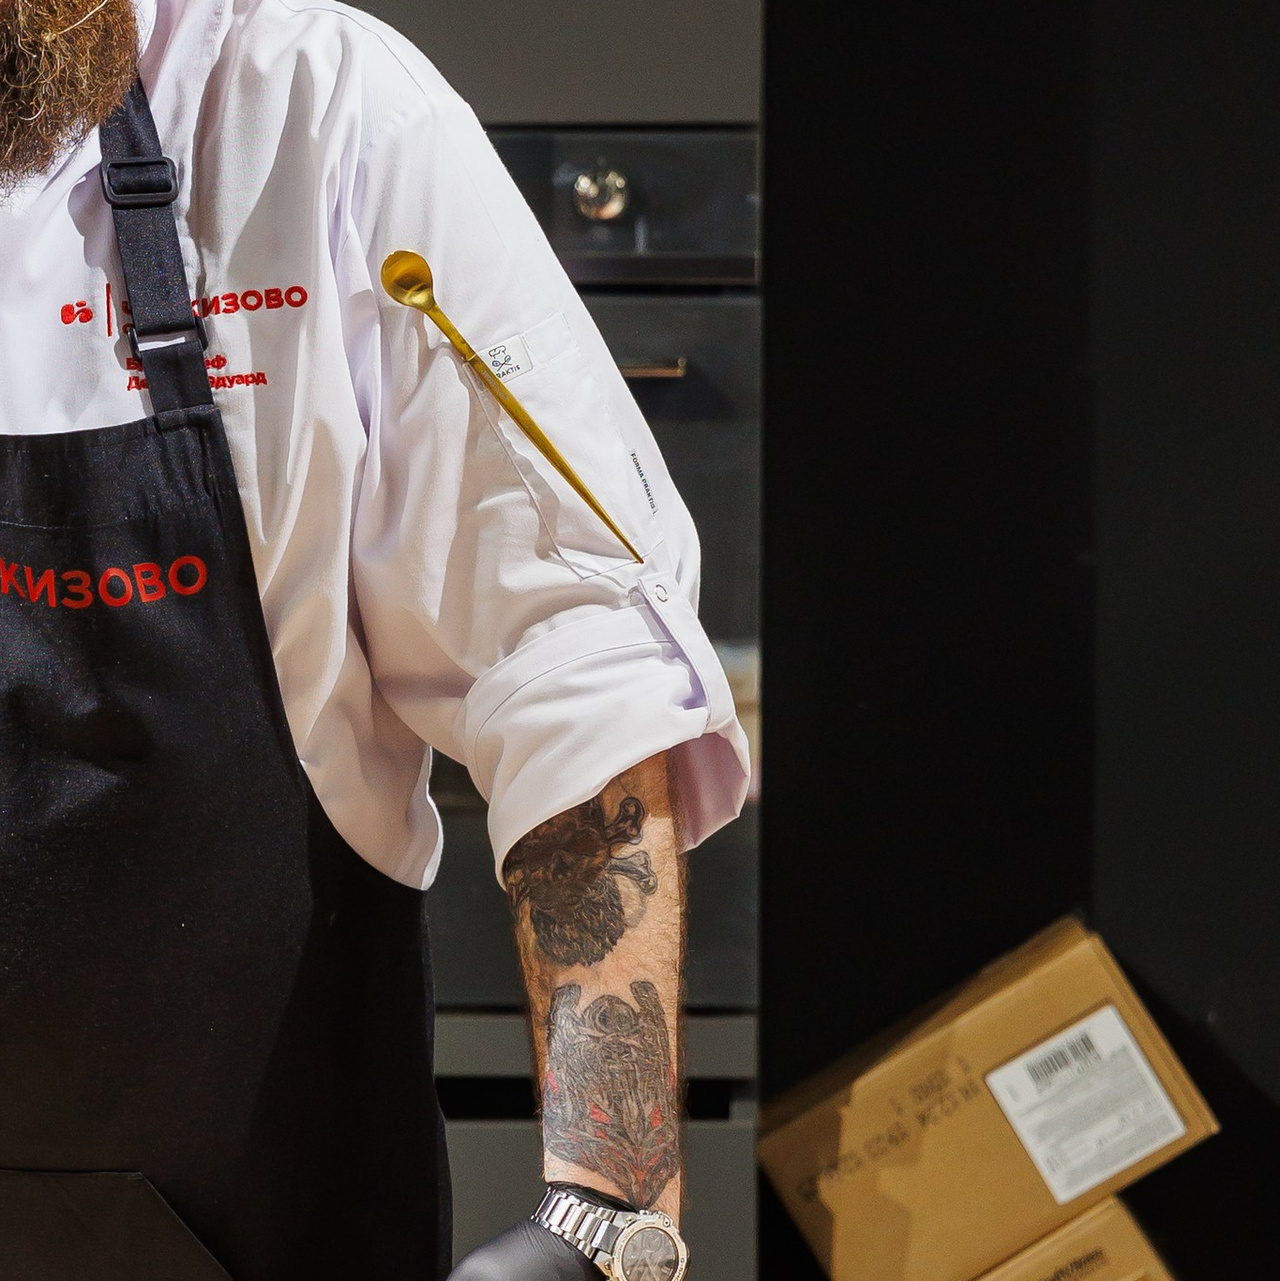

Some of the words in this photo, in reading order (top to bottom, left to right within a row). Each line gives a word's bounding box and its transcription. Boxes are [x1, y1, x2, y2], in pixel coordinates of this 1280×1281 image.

[122, 286, 308, 318] ИЗОВО
[496, 364, 521, 379] RAKTIS
[631, 453, 645, 478] FORMA
